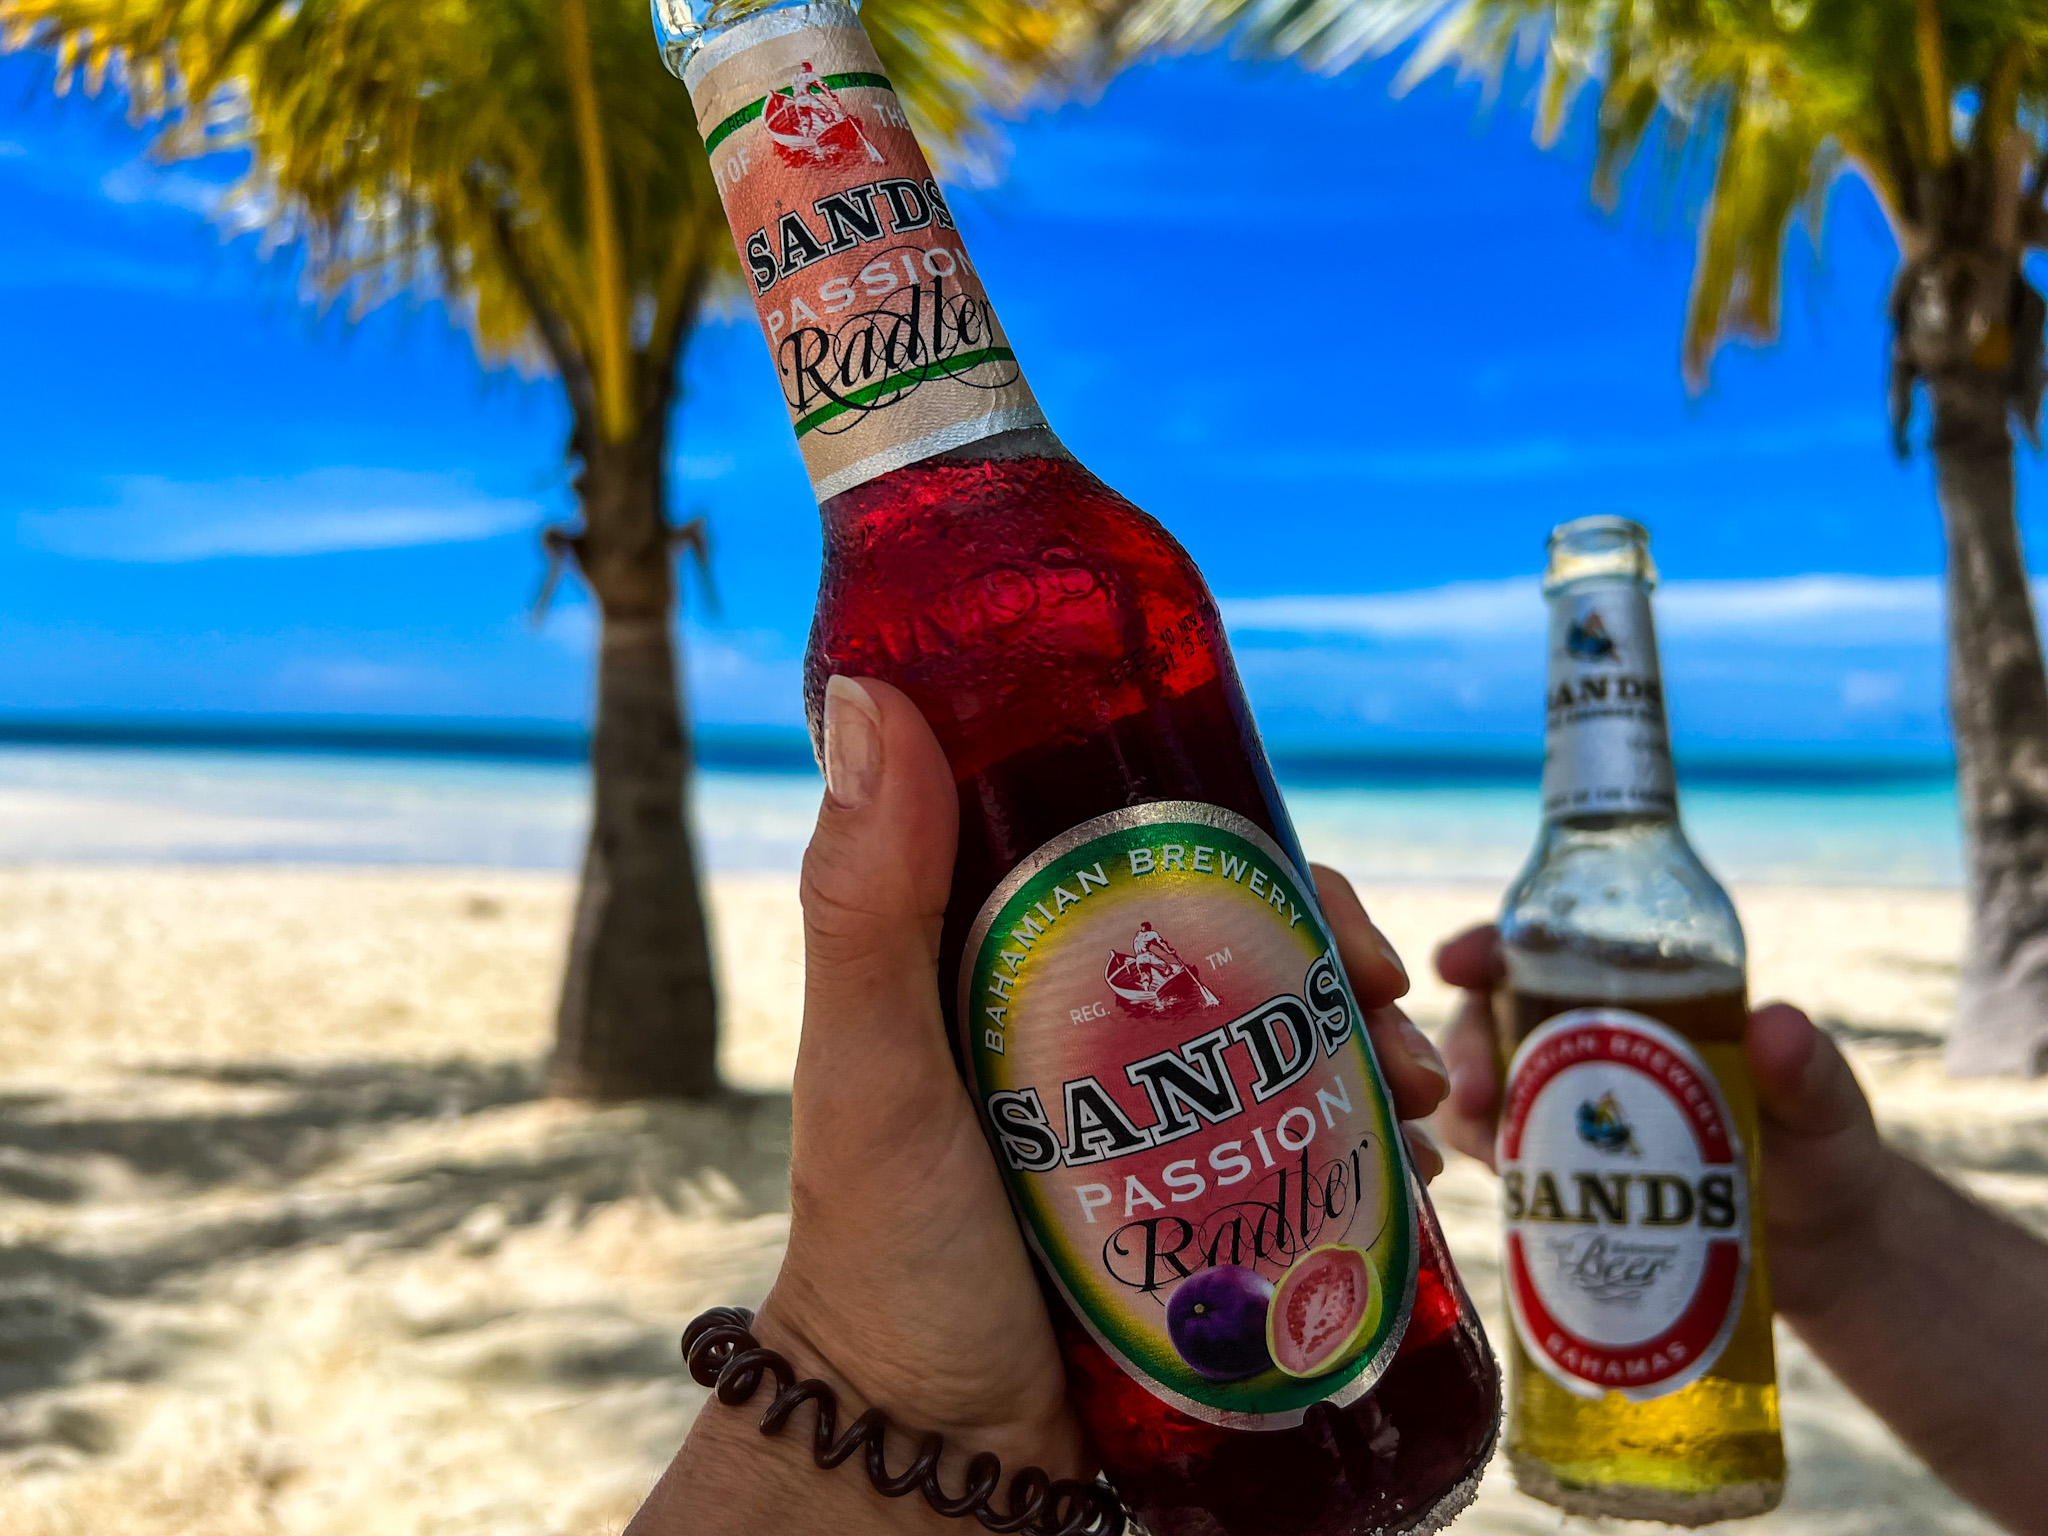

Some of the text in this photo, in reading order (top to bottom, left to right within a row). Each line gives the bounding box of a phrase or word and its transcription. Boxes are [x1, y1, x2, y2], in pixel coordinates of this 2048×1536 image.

[728, 148, 750, 182] OF
[745, 178, 957, 298] SANDS
[778, 246, 1020, 436] Radler
[985, 844, 1303, 1056] BAHAMIAN BREWERY
[1069, 947, 1233, 1026] REG. TM
[986, 949, 1354, 1173] SANDS
[1073, 1075, 1353, 1225] PASSION
[1503, 1169, 1737, 1229] SANDS
[1102, 1131, 1390, 1308] Radler
[1545, 1331, 1688, 1382] BAHAMAS
